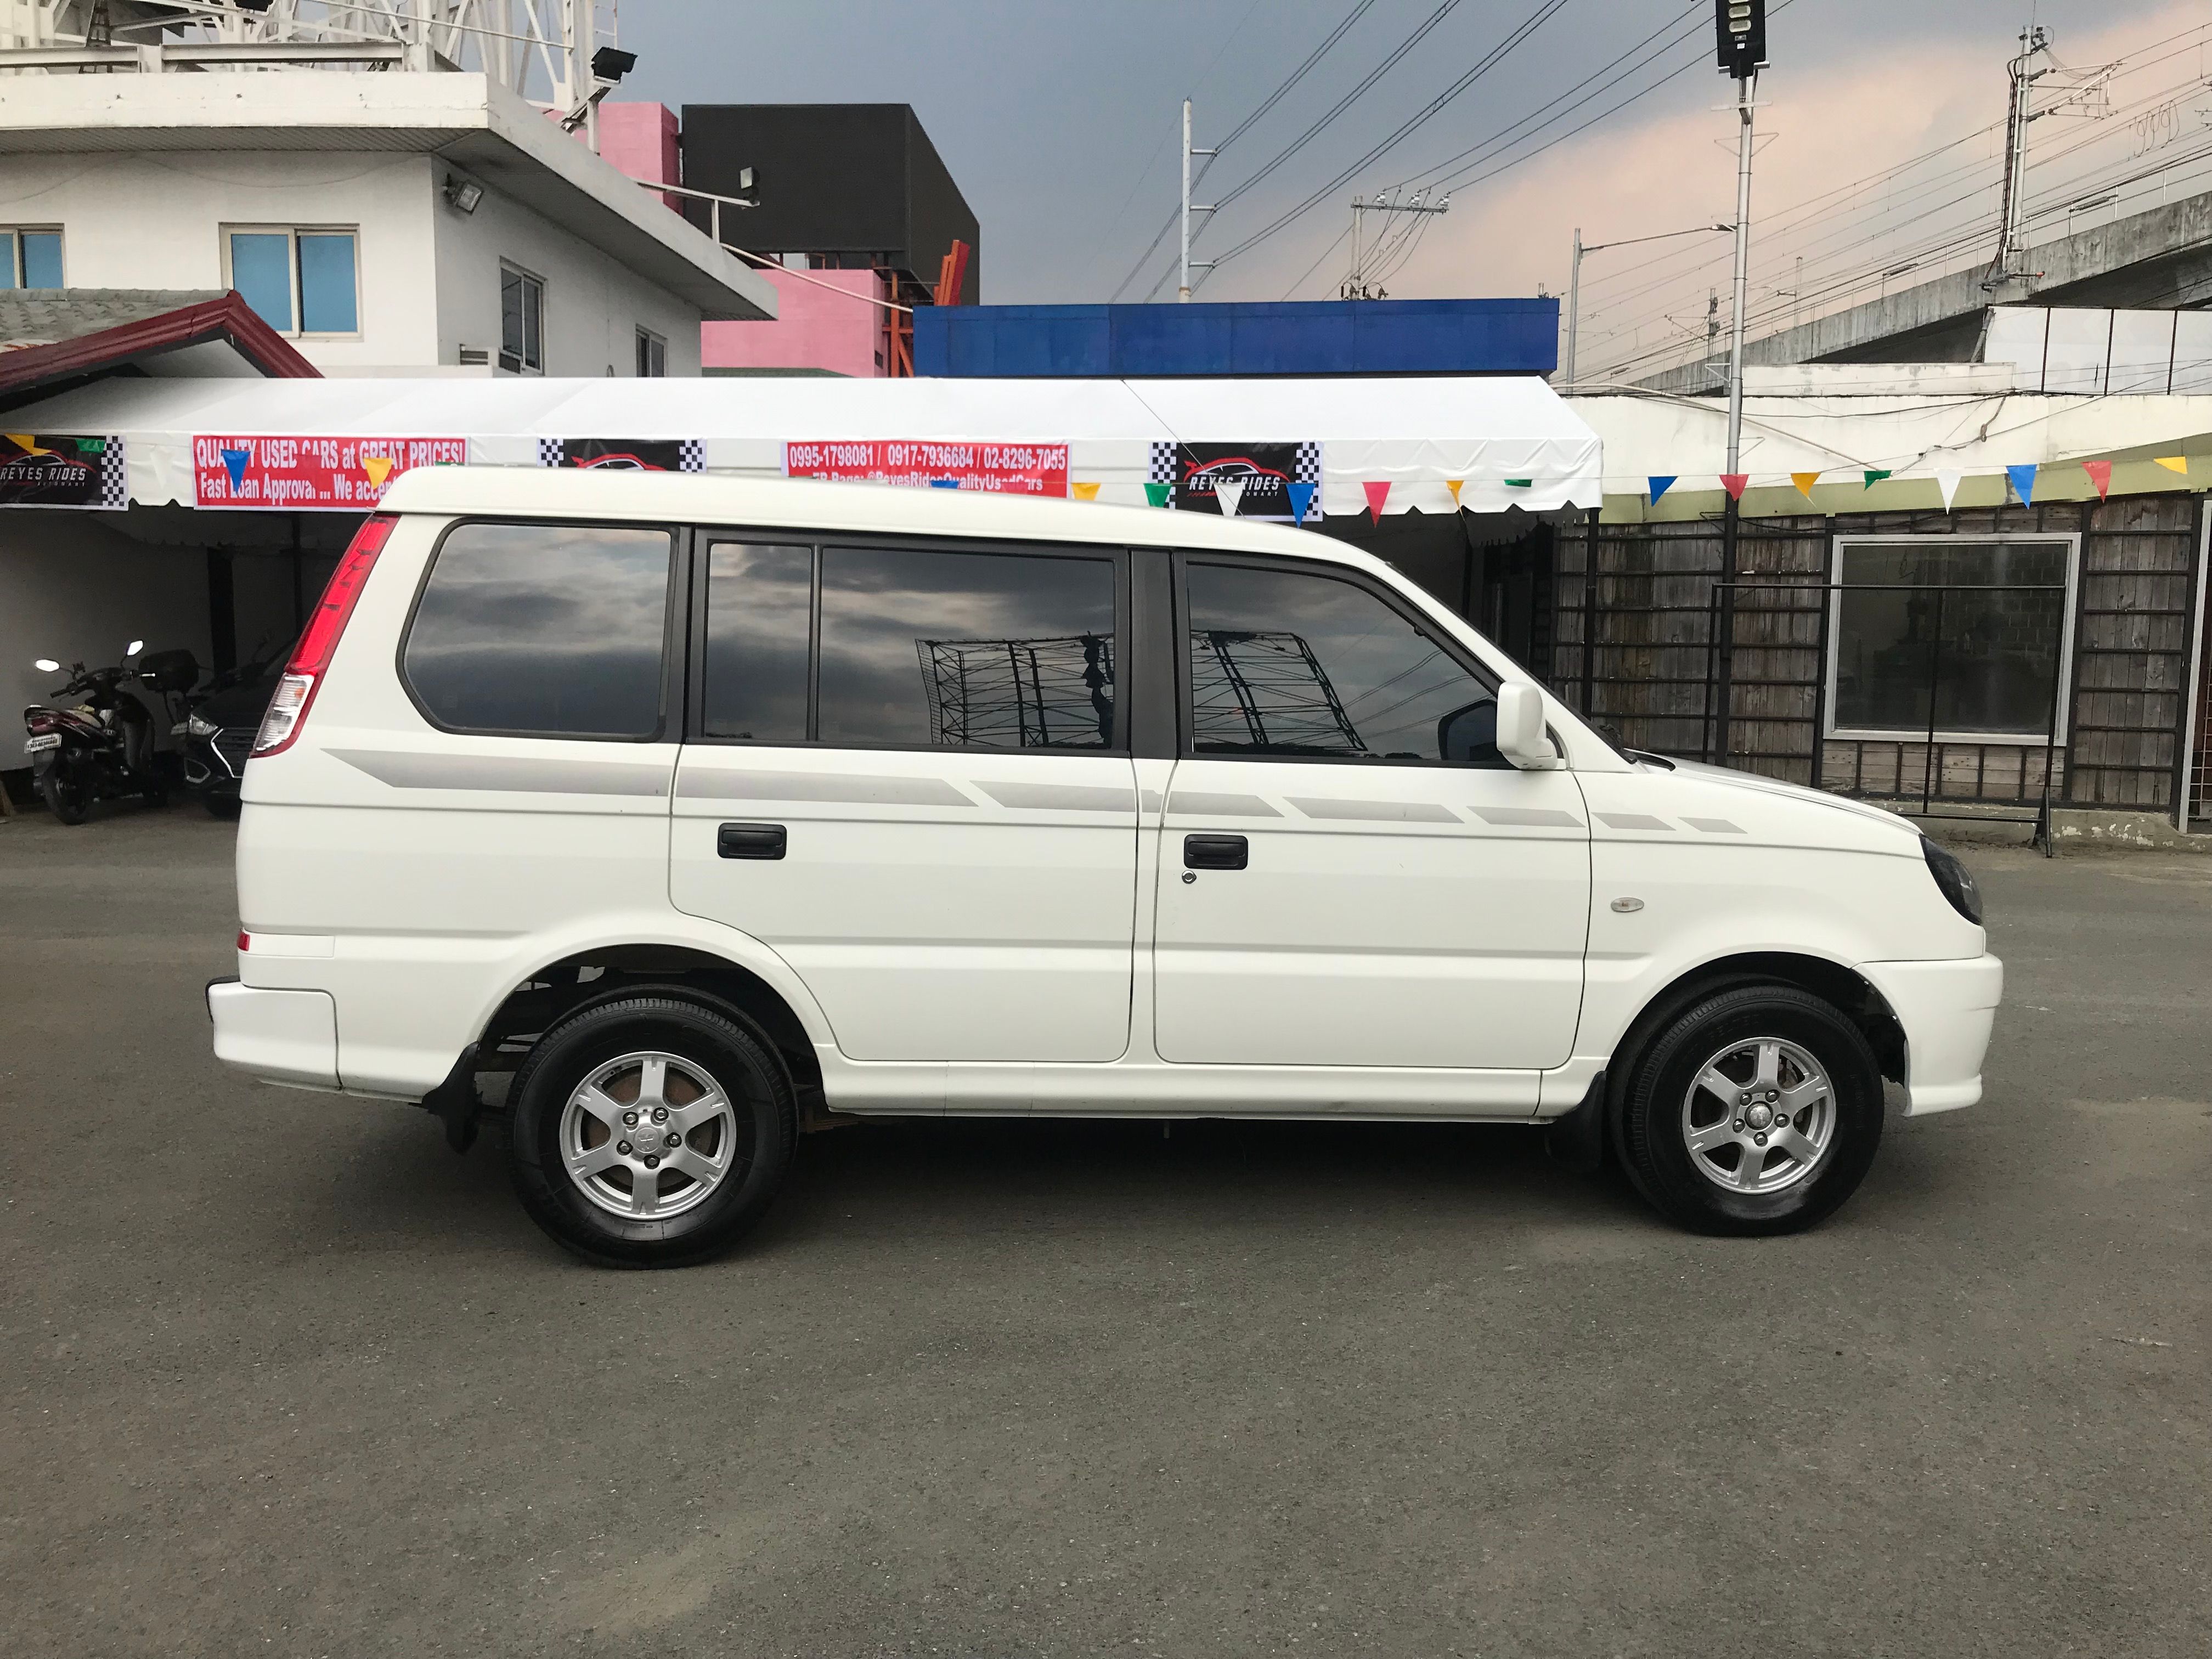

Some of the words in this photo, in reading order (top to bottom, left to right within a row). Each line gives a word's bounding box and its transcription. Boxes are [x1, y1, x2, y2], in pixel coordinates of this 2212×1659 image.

[261, 439, 298, 469] USED
[342, 442, 356, 470] at
[359, 441, 405, 470] GREAT
[789, 445, 873, 468] 0995-1798081
[888, 444, 974, 469] 0917-7936684
[984, 447, 1066, 471] 02-8296-7055
[0, 467, 43, 481] REYES
[48, 467, 87, 481] RIDES
[201, 471, 227, 499] Fast
[333, 473, 353, 500] We
[1240, 476, 1280, 490] RIDES
